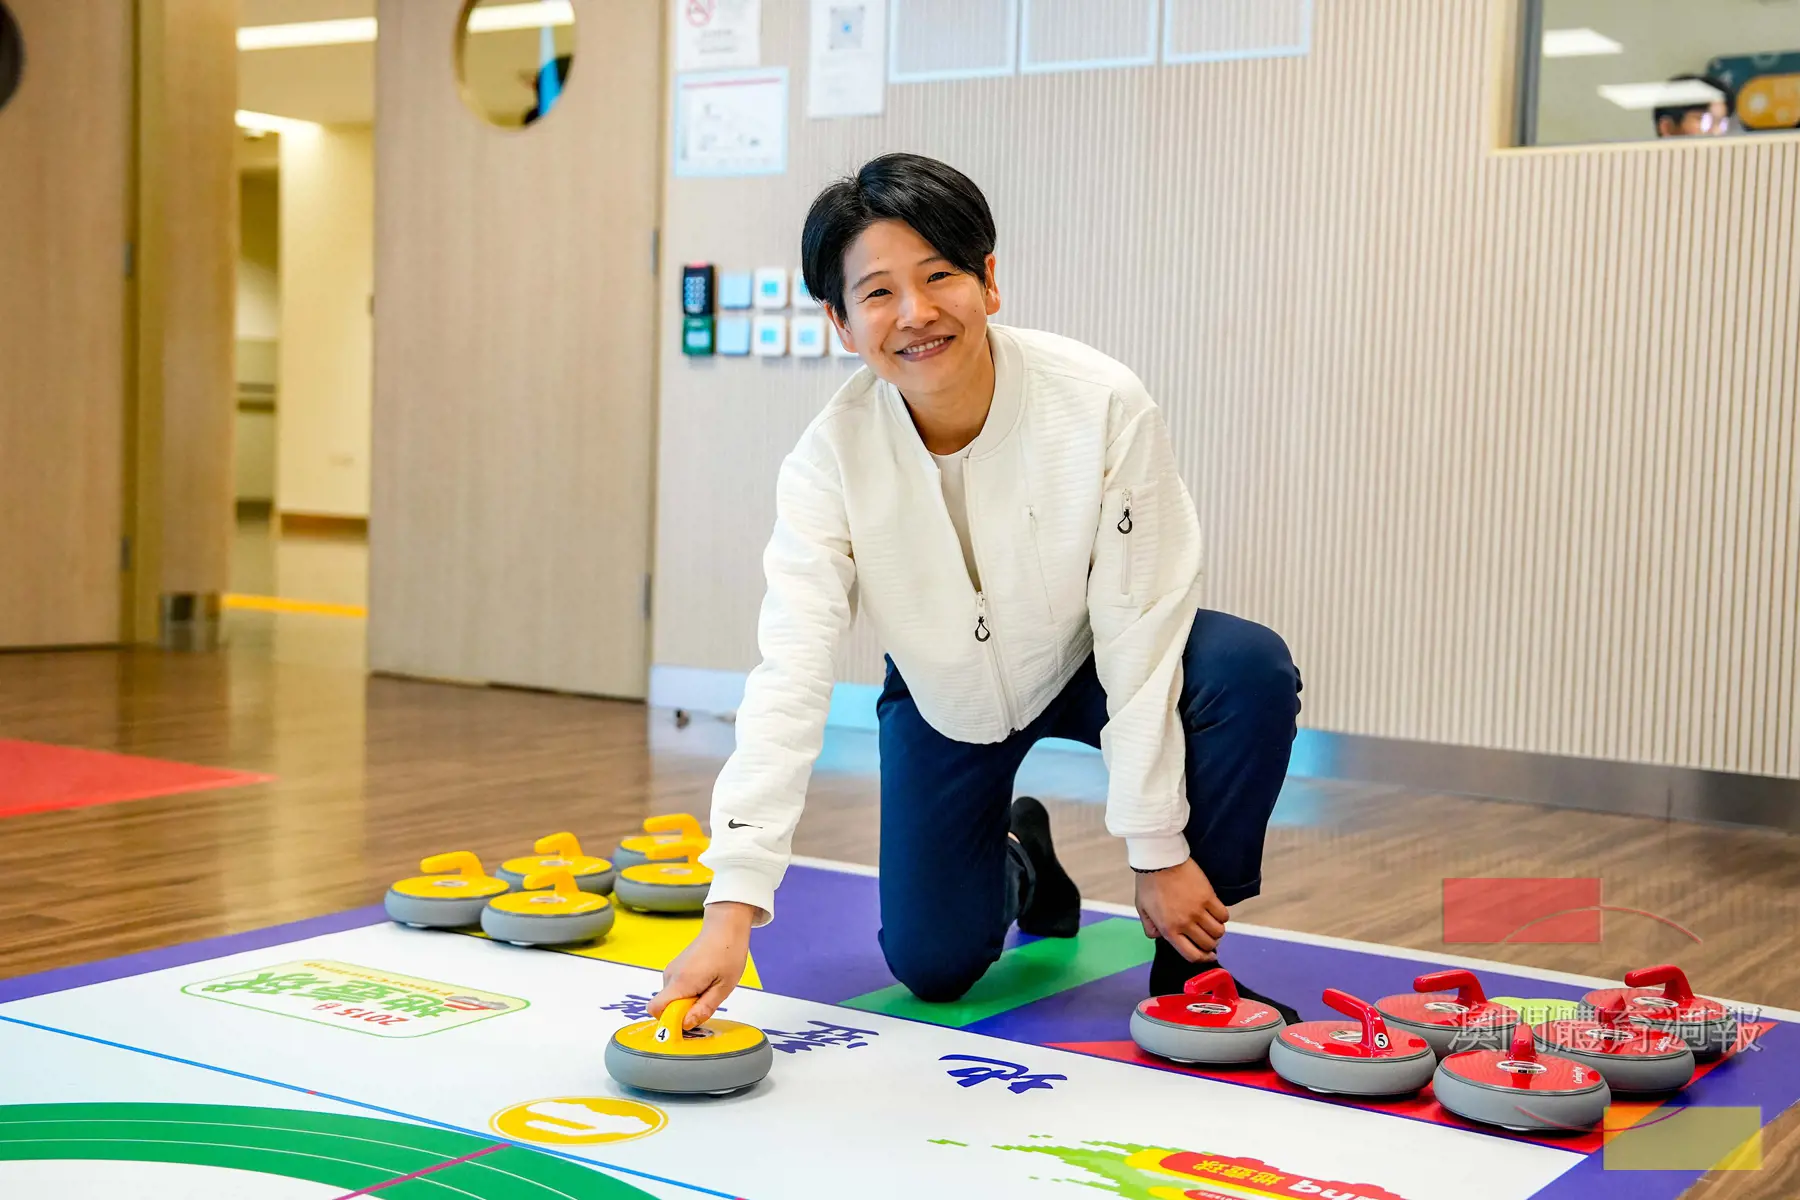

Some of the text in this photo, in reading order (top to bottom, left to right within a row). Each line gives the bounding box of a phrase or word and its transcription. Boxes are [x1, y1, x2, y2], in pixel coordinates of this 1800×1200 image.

[334, 1008, 410, 1026] 2015
[657, 1028, 667, 1042] 4
[1376, 1034, 1387, 1048] 5
[1192, 1160, 1286, 1187] 地壺球
